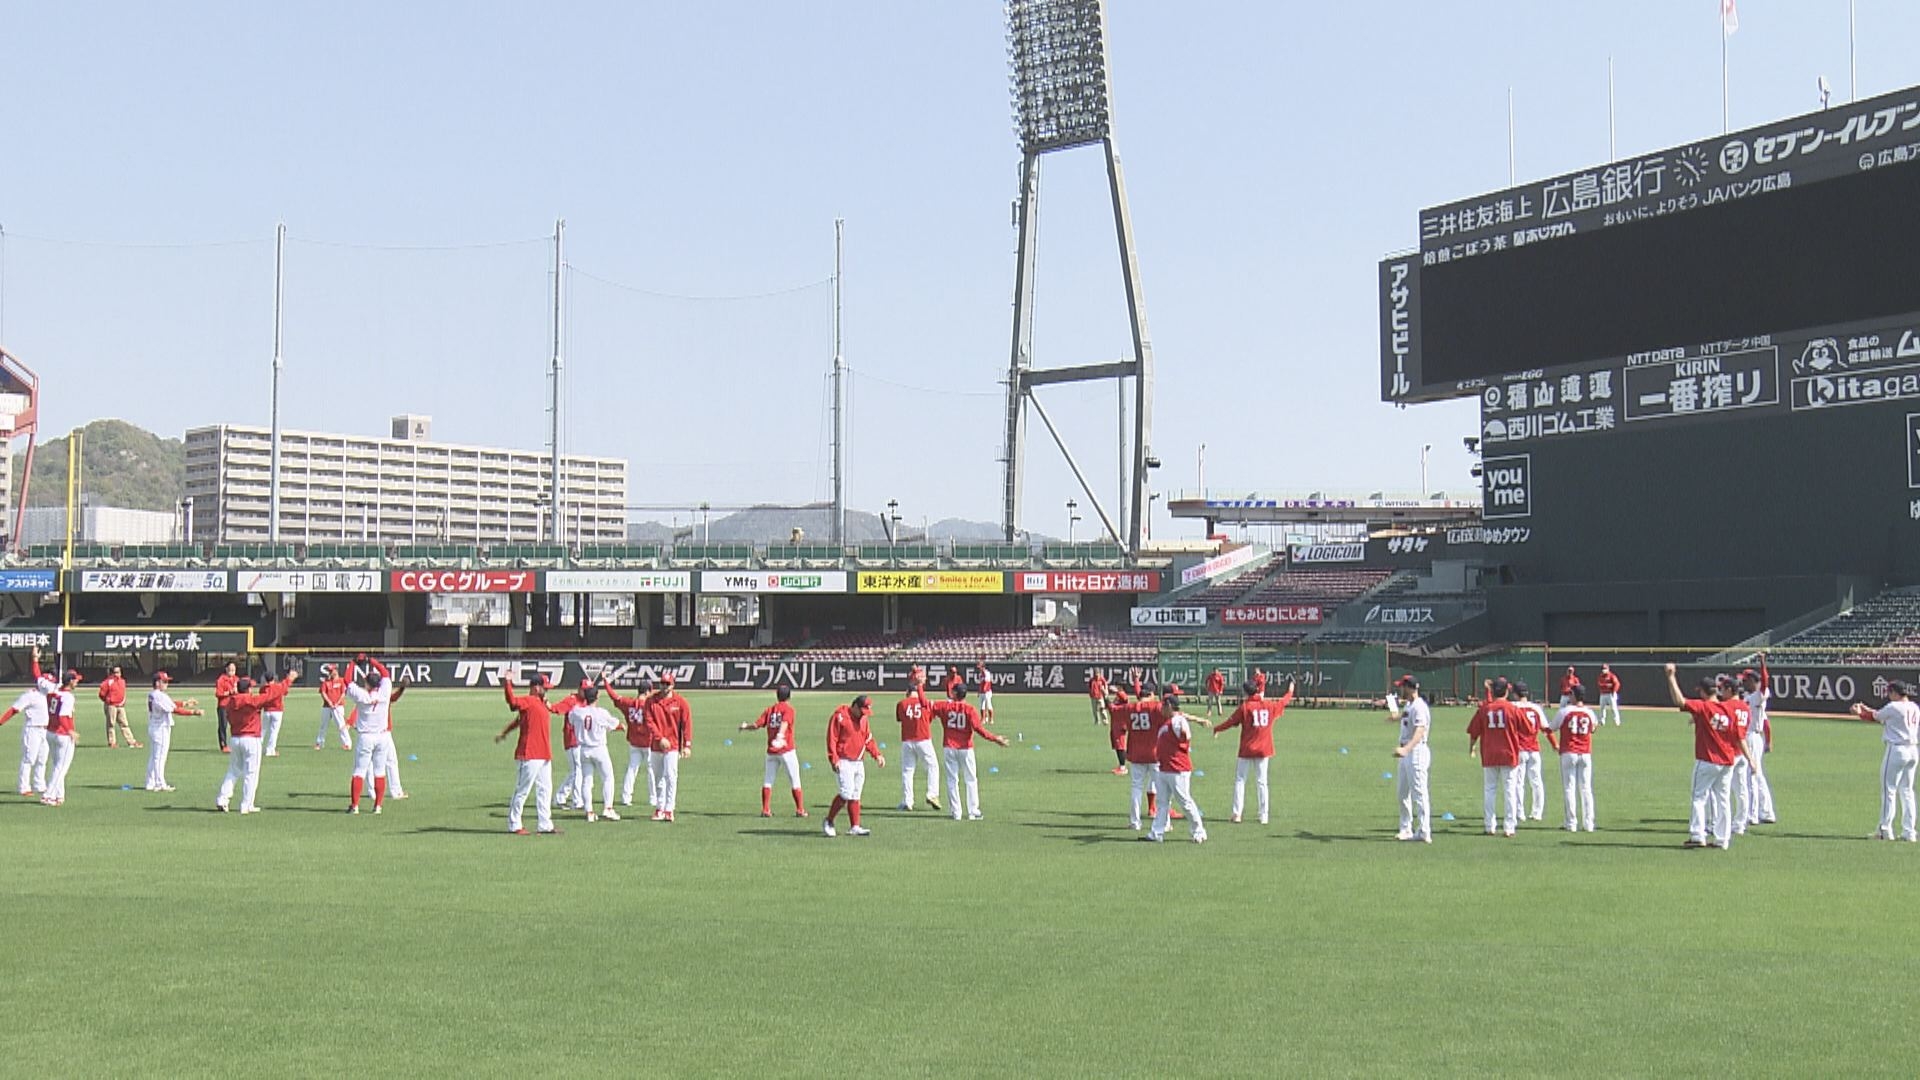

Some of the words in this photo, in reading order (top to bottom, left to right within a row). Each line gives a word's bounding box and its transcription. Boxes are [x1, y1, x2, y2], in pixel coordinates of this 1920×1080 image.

[1878, 143, 1920, 167] 広島ア
[1541, 156, 1667, 220] 広島銀行
[1702, 171, 1791, 206] JAバンク広島
[1422, 195, 1533, 240] 三井住友海上
[1423, 235, 1507, 266] 焙煎ごぼう茶
[1390, 262, 1411, 397] アサヒビール
[1675, 357, 1720, 378] KIRIN
[1506, 371, 1613, 411] 福山通運
[1639, 369, 1761, 412] 一番搾り
[1806, 376, 1920, 408] Kitaga
[1506, 405, 1615, 440] 西川ゴム工業
[1487, 467, 1522, 492] you
[1494, 487, 1525, 506] me
[1483, 526, 1531, 544] ゆめタウン
[1307, 545, 1362, 560] LOGICOM
[1387, 537, 1429, 554] サタケ
[6, 578, 53, 588] アスカネット
[98, 573, 176, 588] 双葉運輸
[289, 572, 373, 590] 中国電力
[400, 572, 527, 591] CGCグループ
[653, 576, 685, 587] FUJI
[724, 576, 758, 590] YMfg
[863, 575, 921, 589] 東洋水産
[939, 576, 967, 584] Smiles
[970, 576, 984, 584] for
[1053, 573, 1149, 590] Hitz日立造船
[1155, 608, 1201, 624] 中電工
[1225, 607, 1265, 621] 生もみじ
[1278, 606, 1319, 621] にしき堂
[1381, 607, 1434, 623] 広島ガス
[319, 663, 432, 683] SNTAR
[730, 660, 825, 689] ユウベル
[965, 667, 1016, 686] Fuuya
[1023, 664, 1065, 689] 福屋
[906, 704, 922, 719] 45
[947, 712, 967, 729] 20
[1130, 712, 1151, 730] 28
[1252, 709, 1270, 726] 18
[1487, 709, 1505, 728] 11
[1568, 715, 1590, 735] 43
